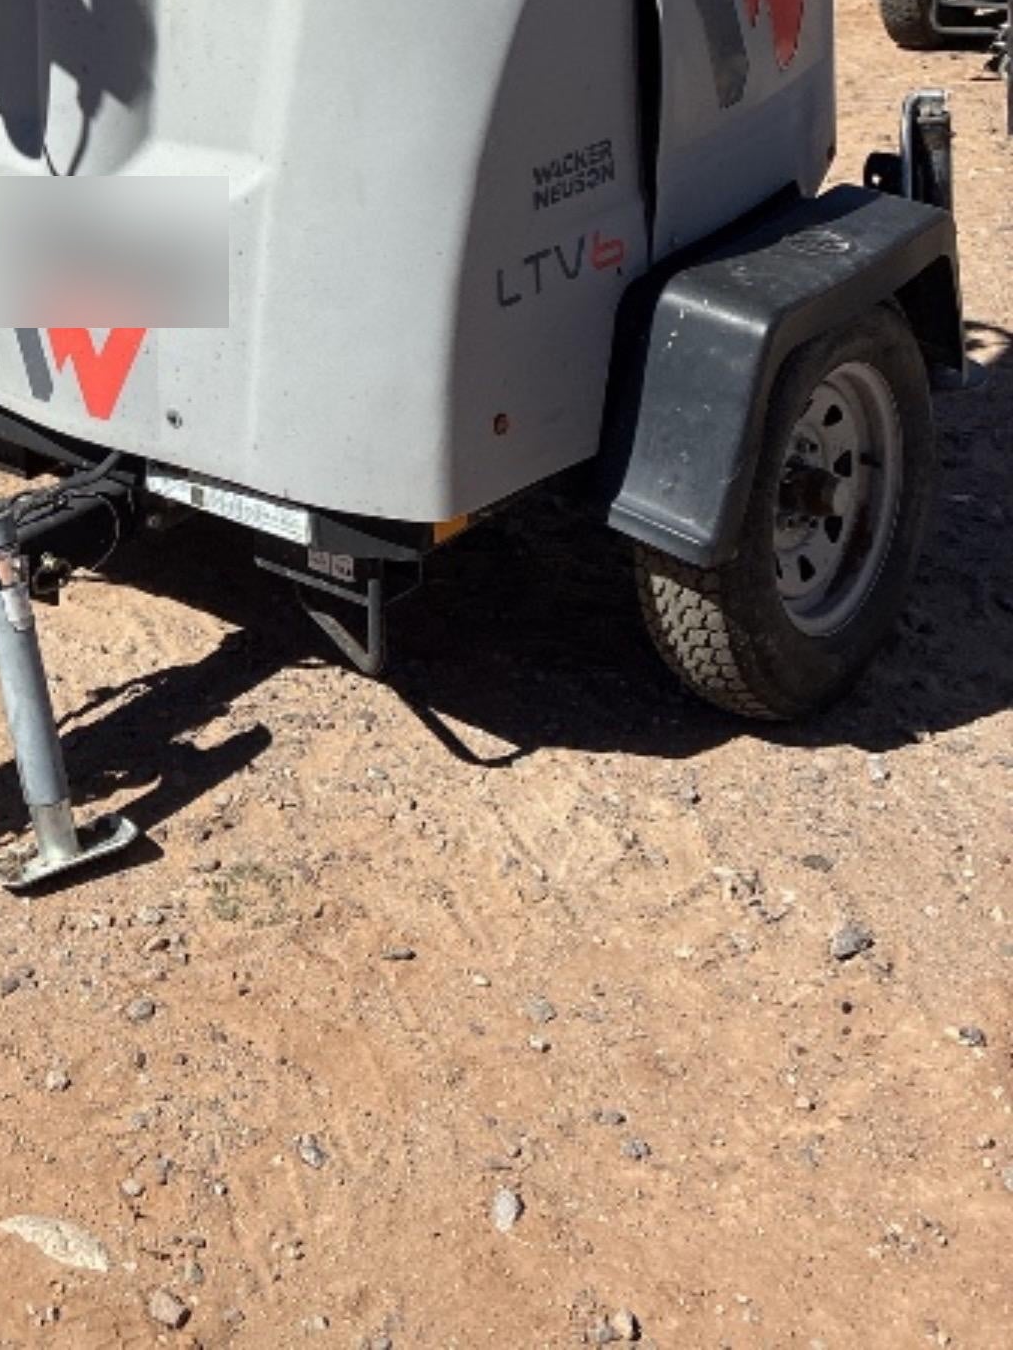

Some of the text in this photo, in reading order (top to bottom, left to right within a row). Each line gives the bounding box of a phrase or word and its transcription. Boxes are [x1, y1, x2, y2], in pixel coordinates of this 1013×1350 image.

[532, 138, 613, 186] WACKER
[533, 159, 615, 211] NEUSON
[496, 229, 625, 308] LTV6
